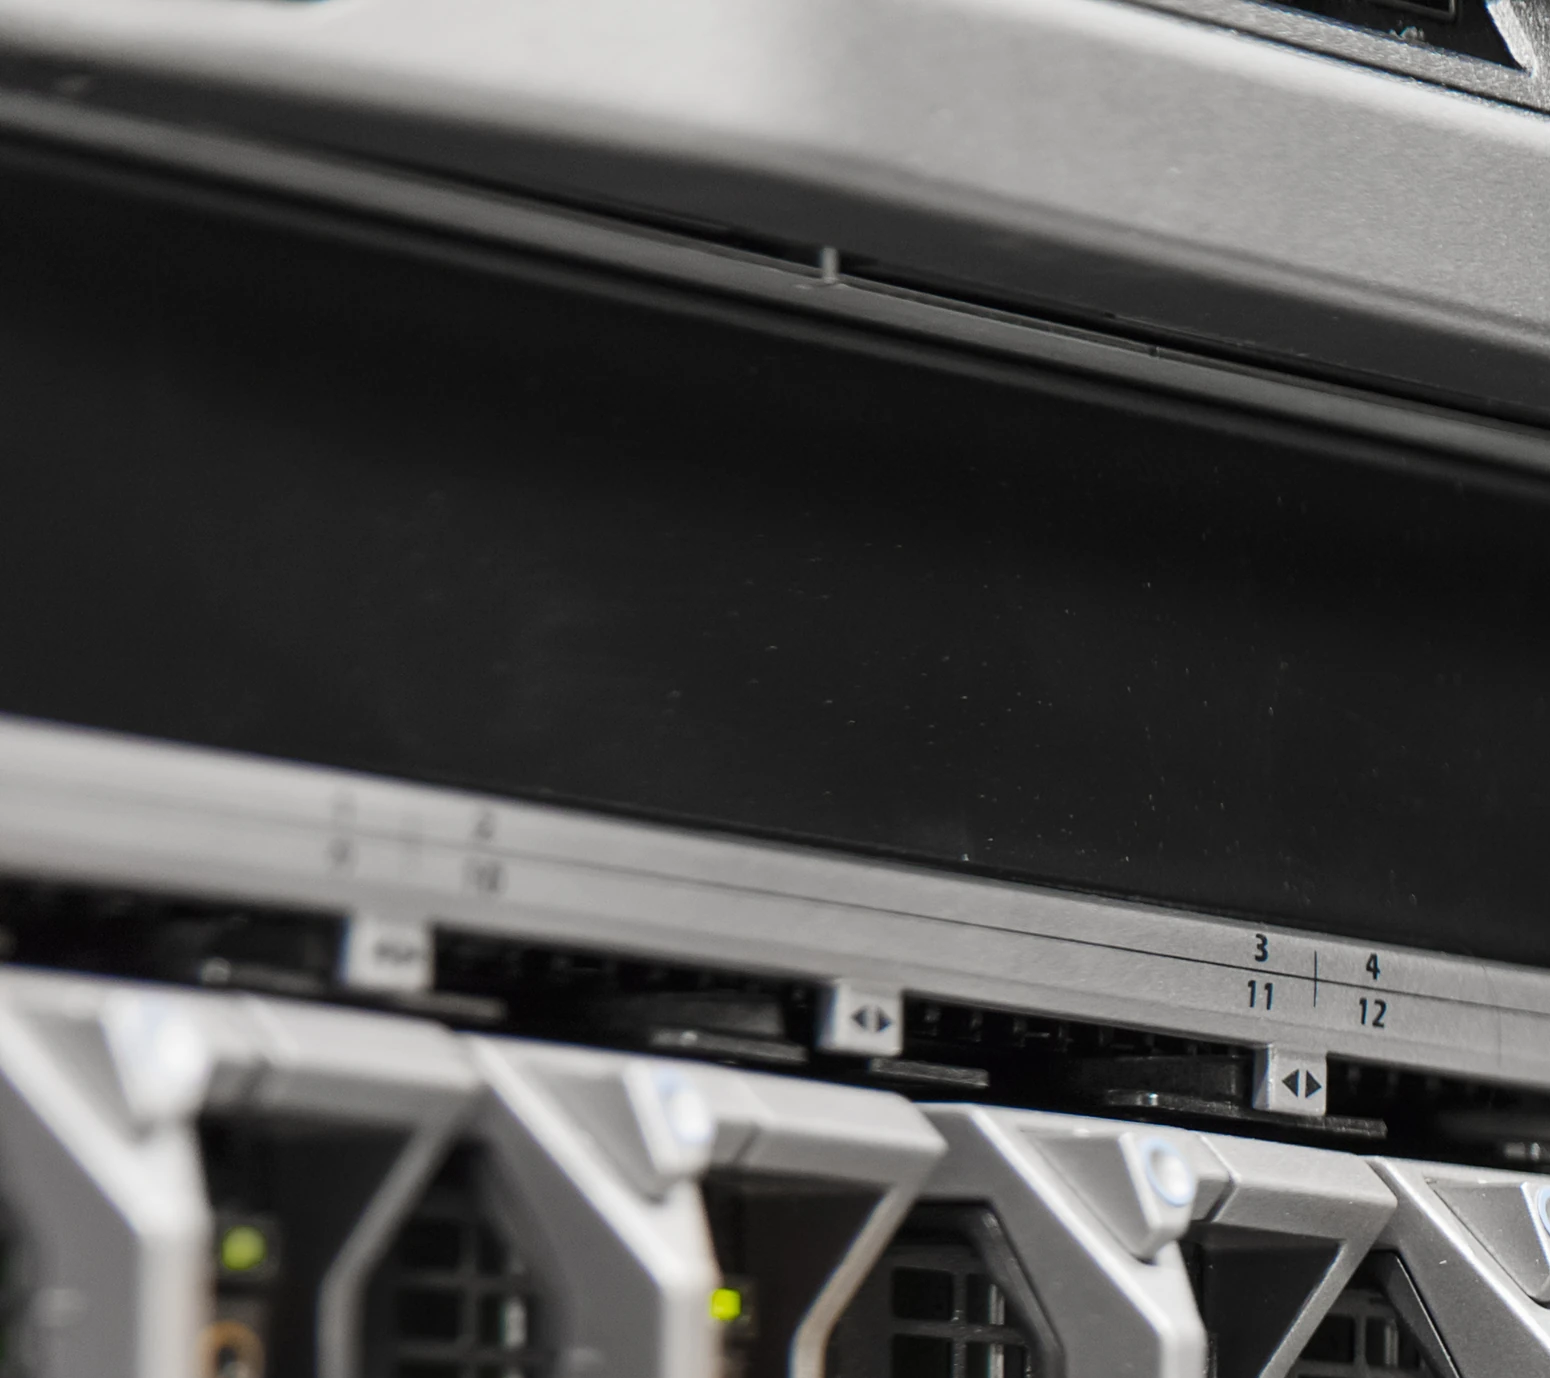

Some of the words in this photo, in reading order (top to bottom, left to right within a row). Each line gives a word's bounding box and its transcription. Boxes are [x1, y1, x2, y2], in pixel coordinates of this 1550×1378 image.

[1254, 933, 1268, 962] 3
[1365, 952, 1380, 980] 4
[1247, 980, 1273, 1010] 11
[1359, 997, 1387, 1028] 12
